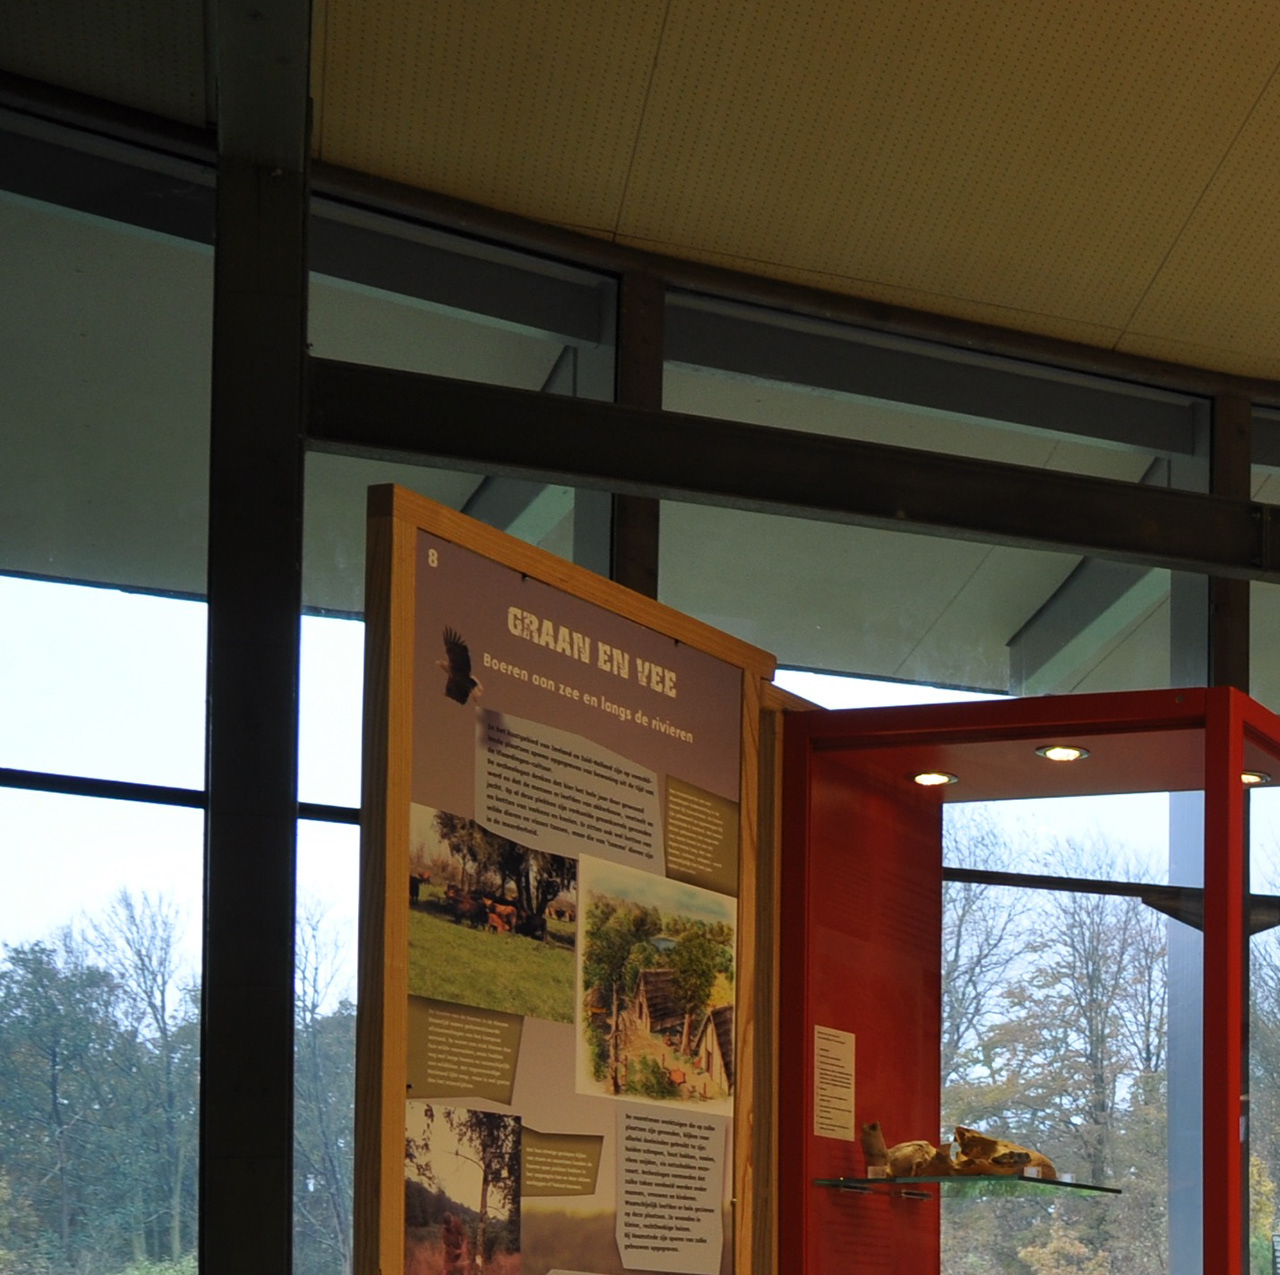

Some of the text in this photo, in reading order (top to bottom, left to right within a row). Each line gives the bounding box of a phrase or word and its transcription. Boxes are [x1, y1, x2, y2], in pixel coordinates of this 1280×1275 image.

[428, 549, 438, 567] 8
[483, 652, 693, 743] Boeren aan zee en langs de rivieren
[507, 606, 677, 698] GRAAN EN VEE
